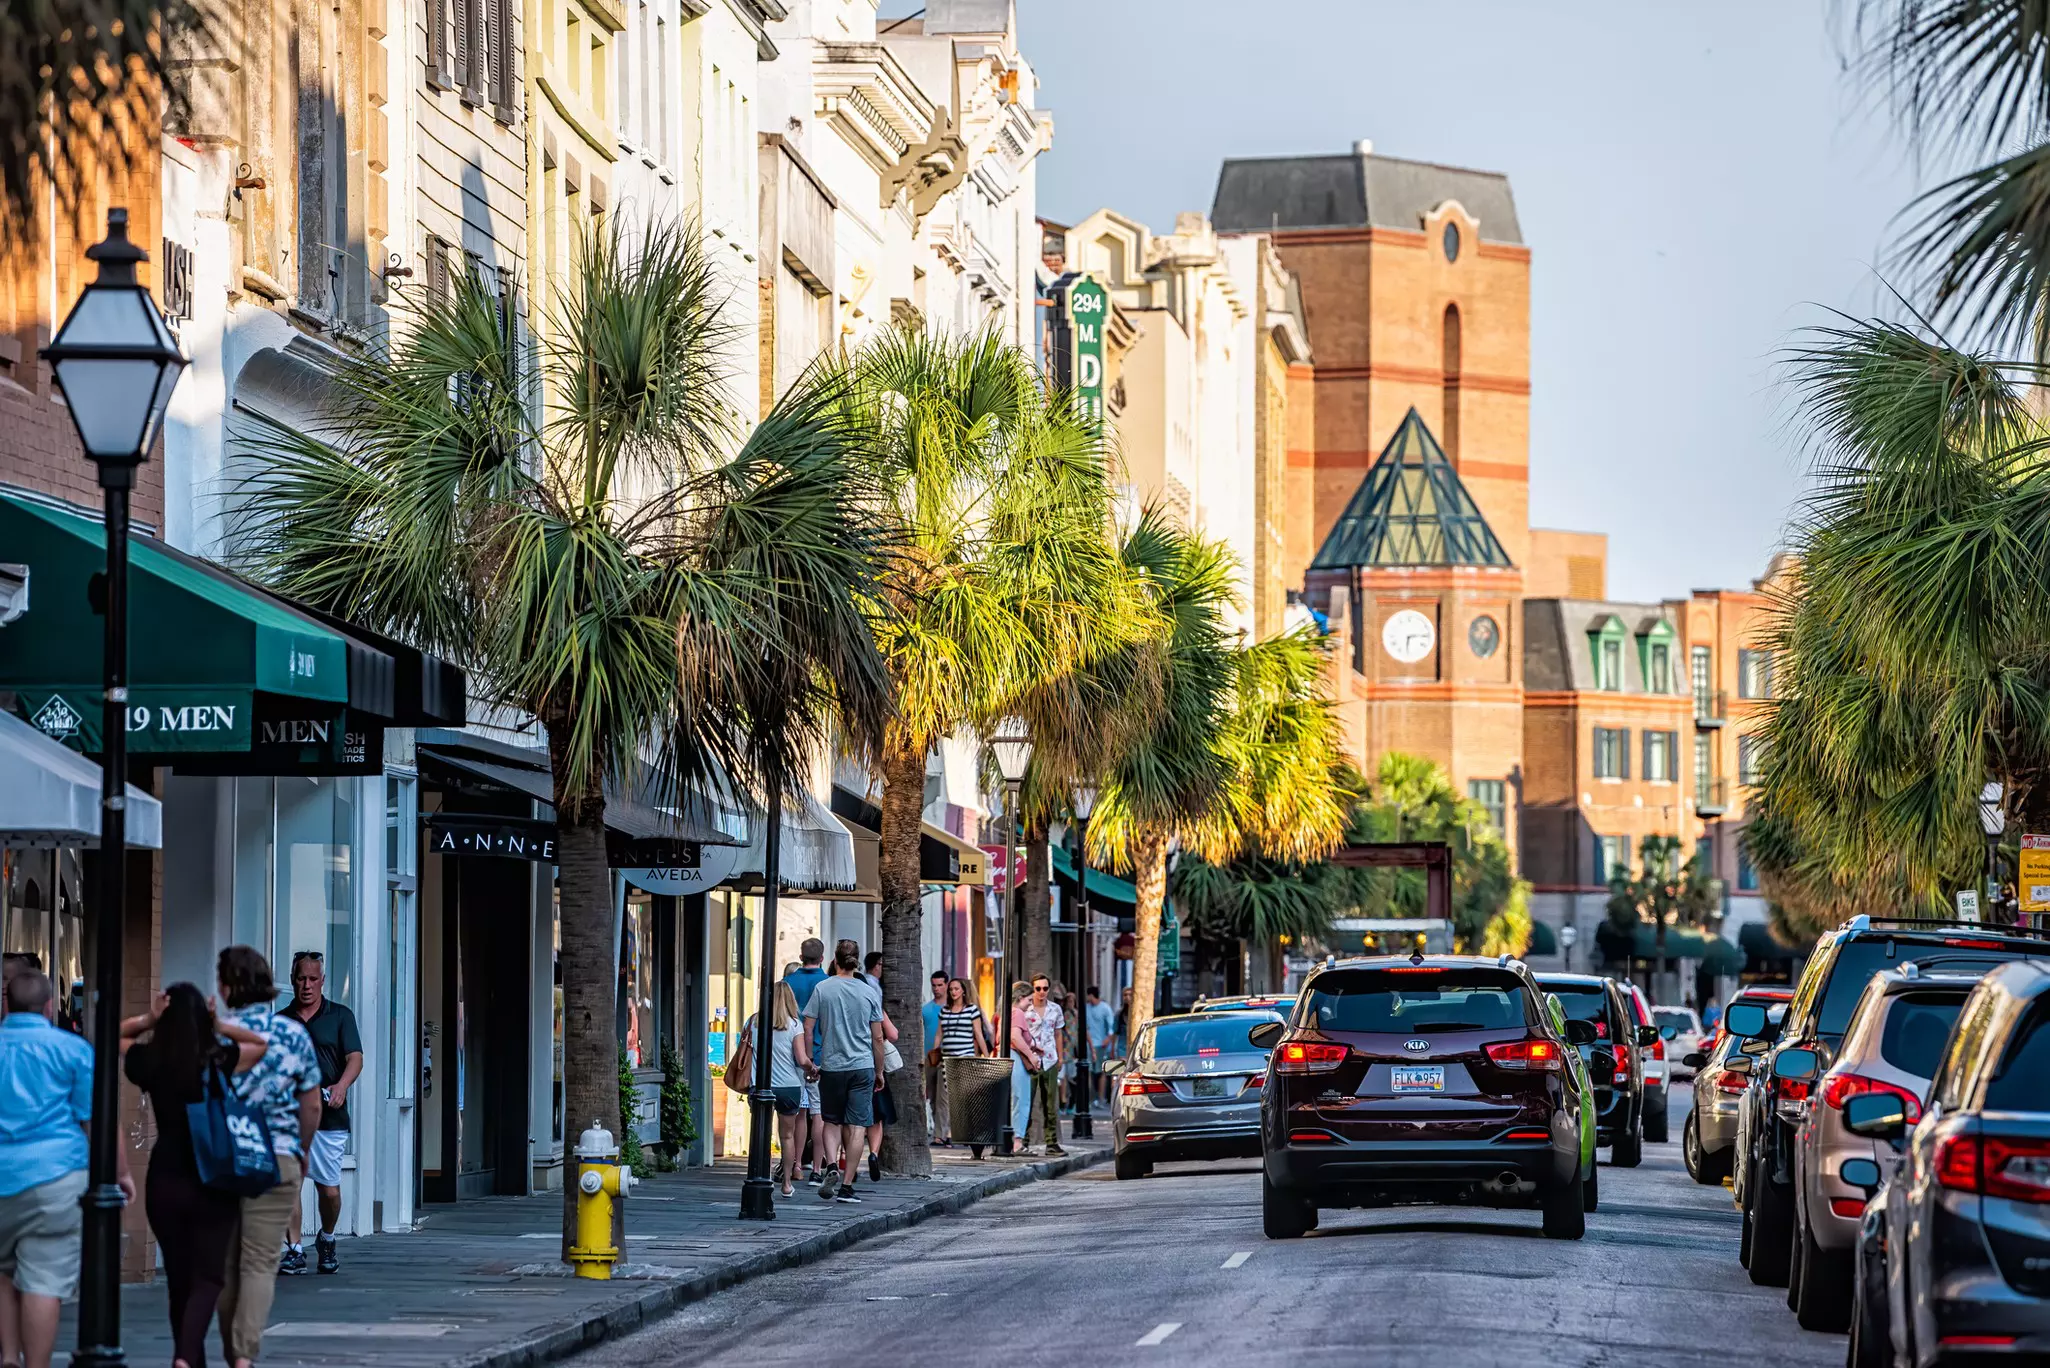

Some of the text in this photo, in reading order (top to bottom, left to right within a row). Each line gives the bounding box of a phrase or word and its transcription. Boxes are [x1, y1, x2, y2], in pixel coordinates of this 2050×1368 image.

[1073, 293, 1102, 313] 294
[1080, 324, 1098, 343] M.
[160, 706, 236, 731] MEN
[261, 720, 330, 743] MEN
[344, 733, 366, 745] SH
[2022, 839, 2032, 849] NO
[646, 869, 702, 882] AVEDA
[1962, 897, 1975, 907] BIKE
[1408, 1042, 1425, 1050] KIA
[1395, 1073, 1441, 1085] FLK 957
